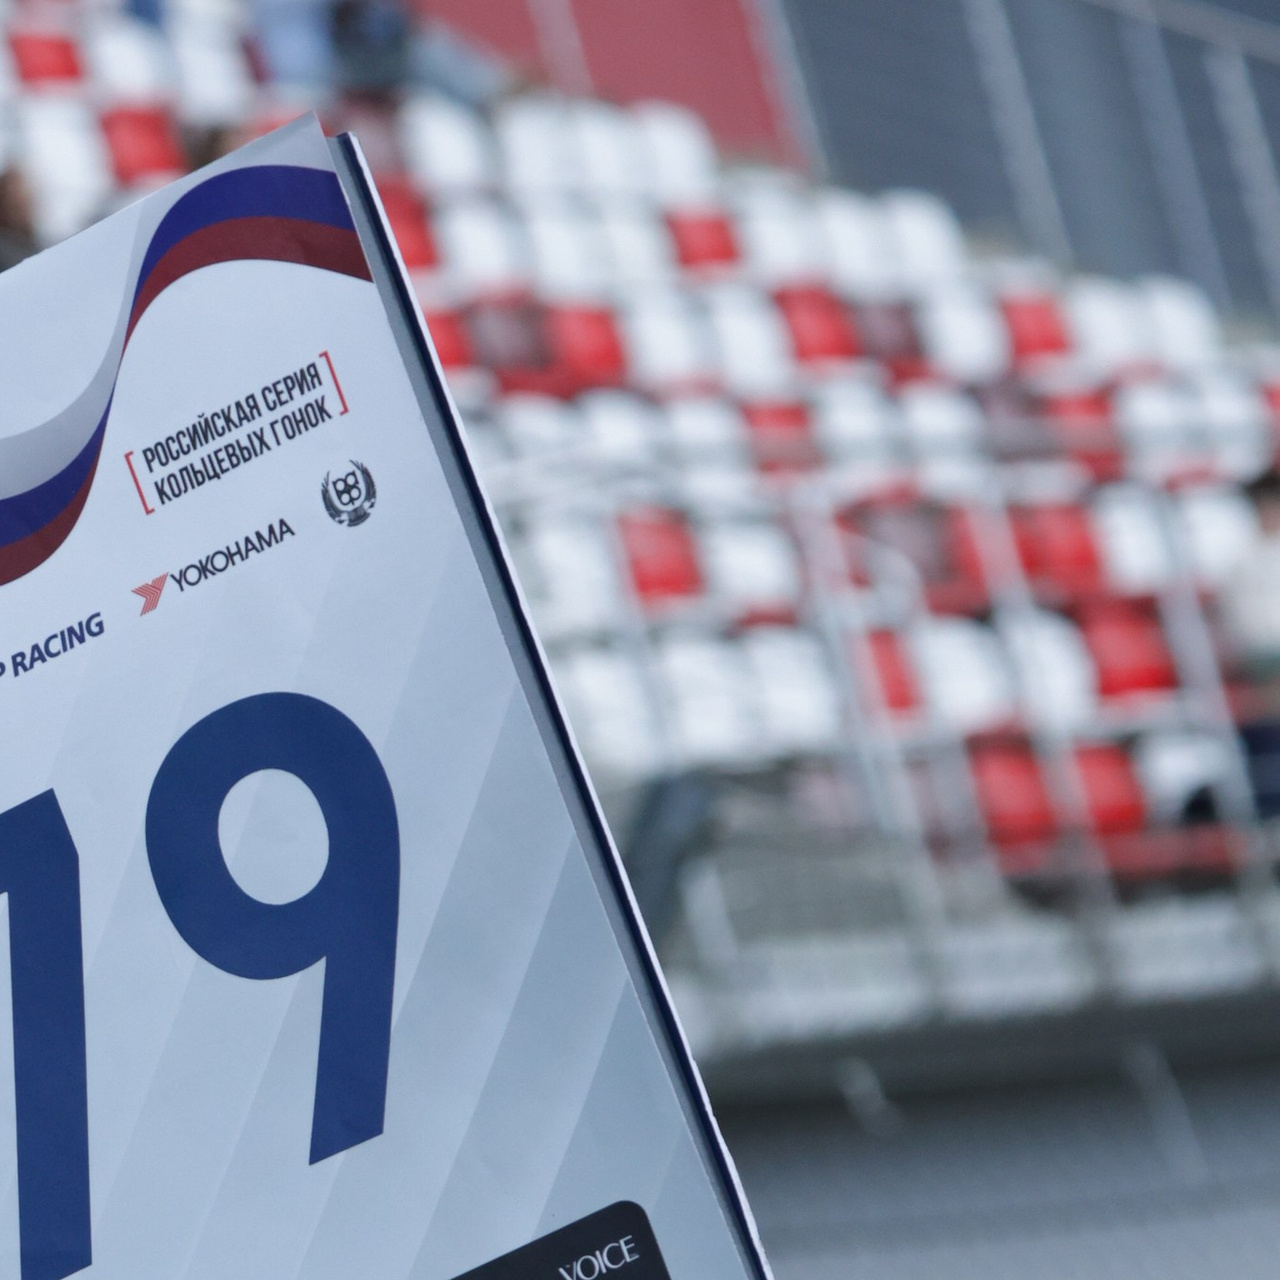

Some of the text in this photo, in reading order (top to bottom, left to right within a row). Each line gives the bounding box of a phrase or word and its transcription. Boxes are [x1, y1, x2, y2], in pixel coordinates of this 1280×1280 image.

[142, 362, 324, 473] РОССИЙСКАЯ СЕРИЯ
[154, 396, 333, 506] КОЛЬЦЕВЫХ ГОНОК
[169, 517, 296, 592] YOKOHAMA
[10, 611, 105, 677] RACING
